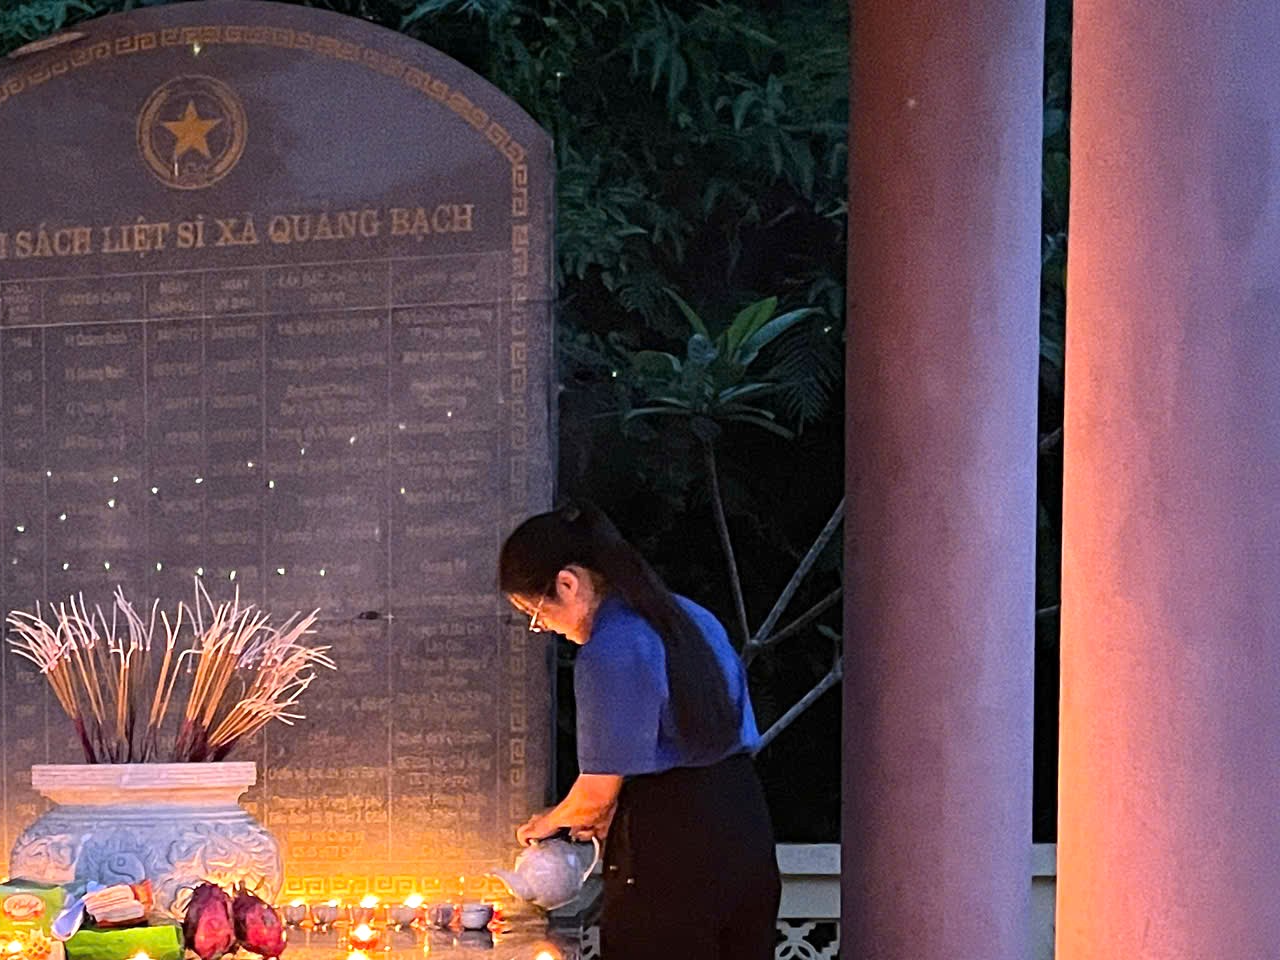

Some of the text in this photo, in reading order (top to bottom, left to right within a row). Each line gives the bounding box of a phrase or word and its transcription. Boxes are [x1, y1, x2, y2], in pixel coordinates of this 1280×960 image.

[15, 223, 93, 258] SÁCH
[101, 216, 170, 258] LIỆT
[389, 203, 475, 242] BẠCH
